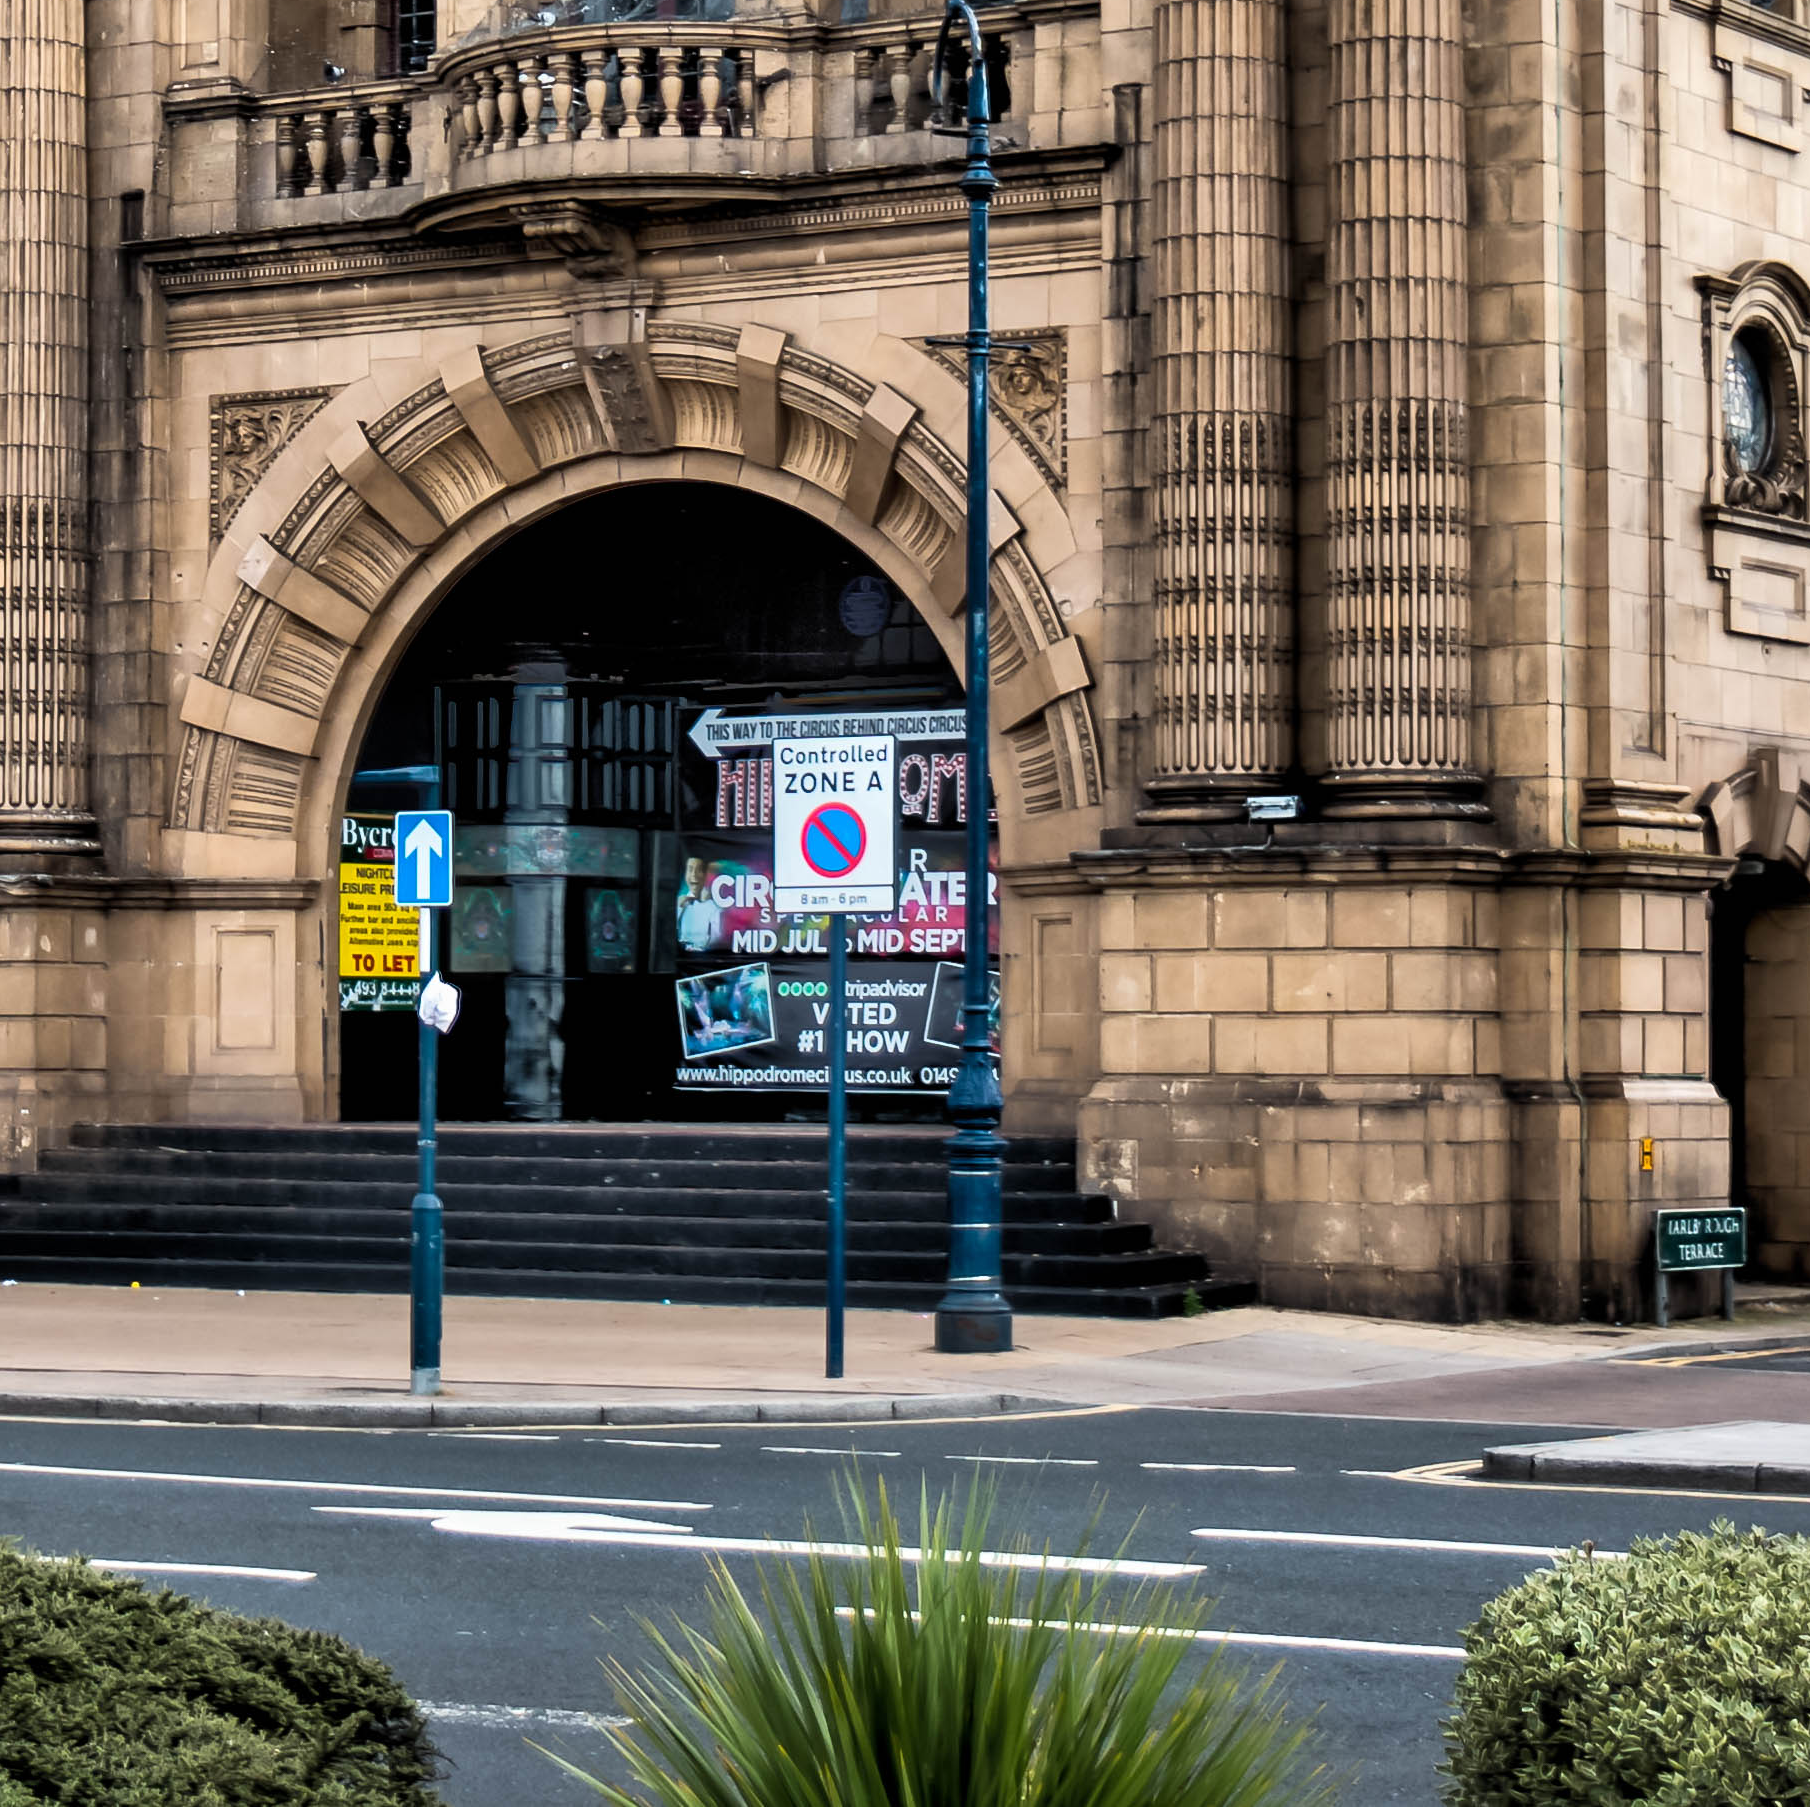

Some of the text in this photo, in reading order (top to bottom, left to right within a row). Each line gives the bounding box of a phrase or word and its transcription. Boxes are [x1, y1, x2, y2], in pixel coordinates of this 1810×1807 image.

[706, 714, 966, 742] THIS WAY TO THE CIRCUS BEHIND CIRCUS CIRCUS
[780, 743, 888, 765] Controlled
[784, 770, 883, 794] ZONE A
[732, 929, 778, 954] MID
[857, 928, 904, 953] MID
[352, 953, 416, 973] TO LET
[812, 1002, 898, 1025] VTED
[797, 1029, 910, 1054] #1 HOW
[1678, 1242, 1725, 1261] TERRACE
